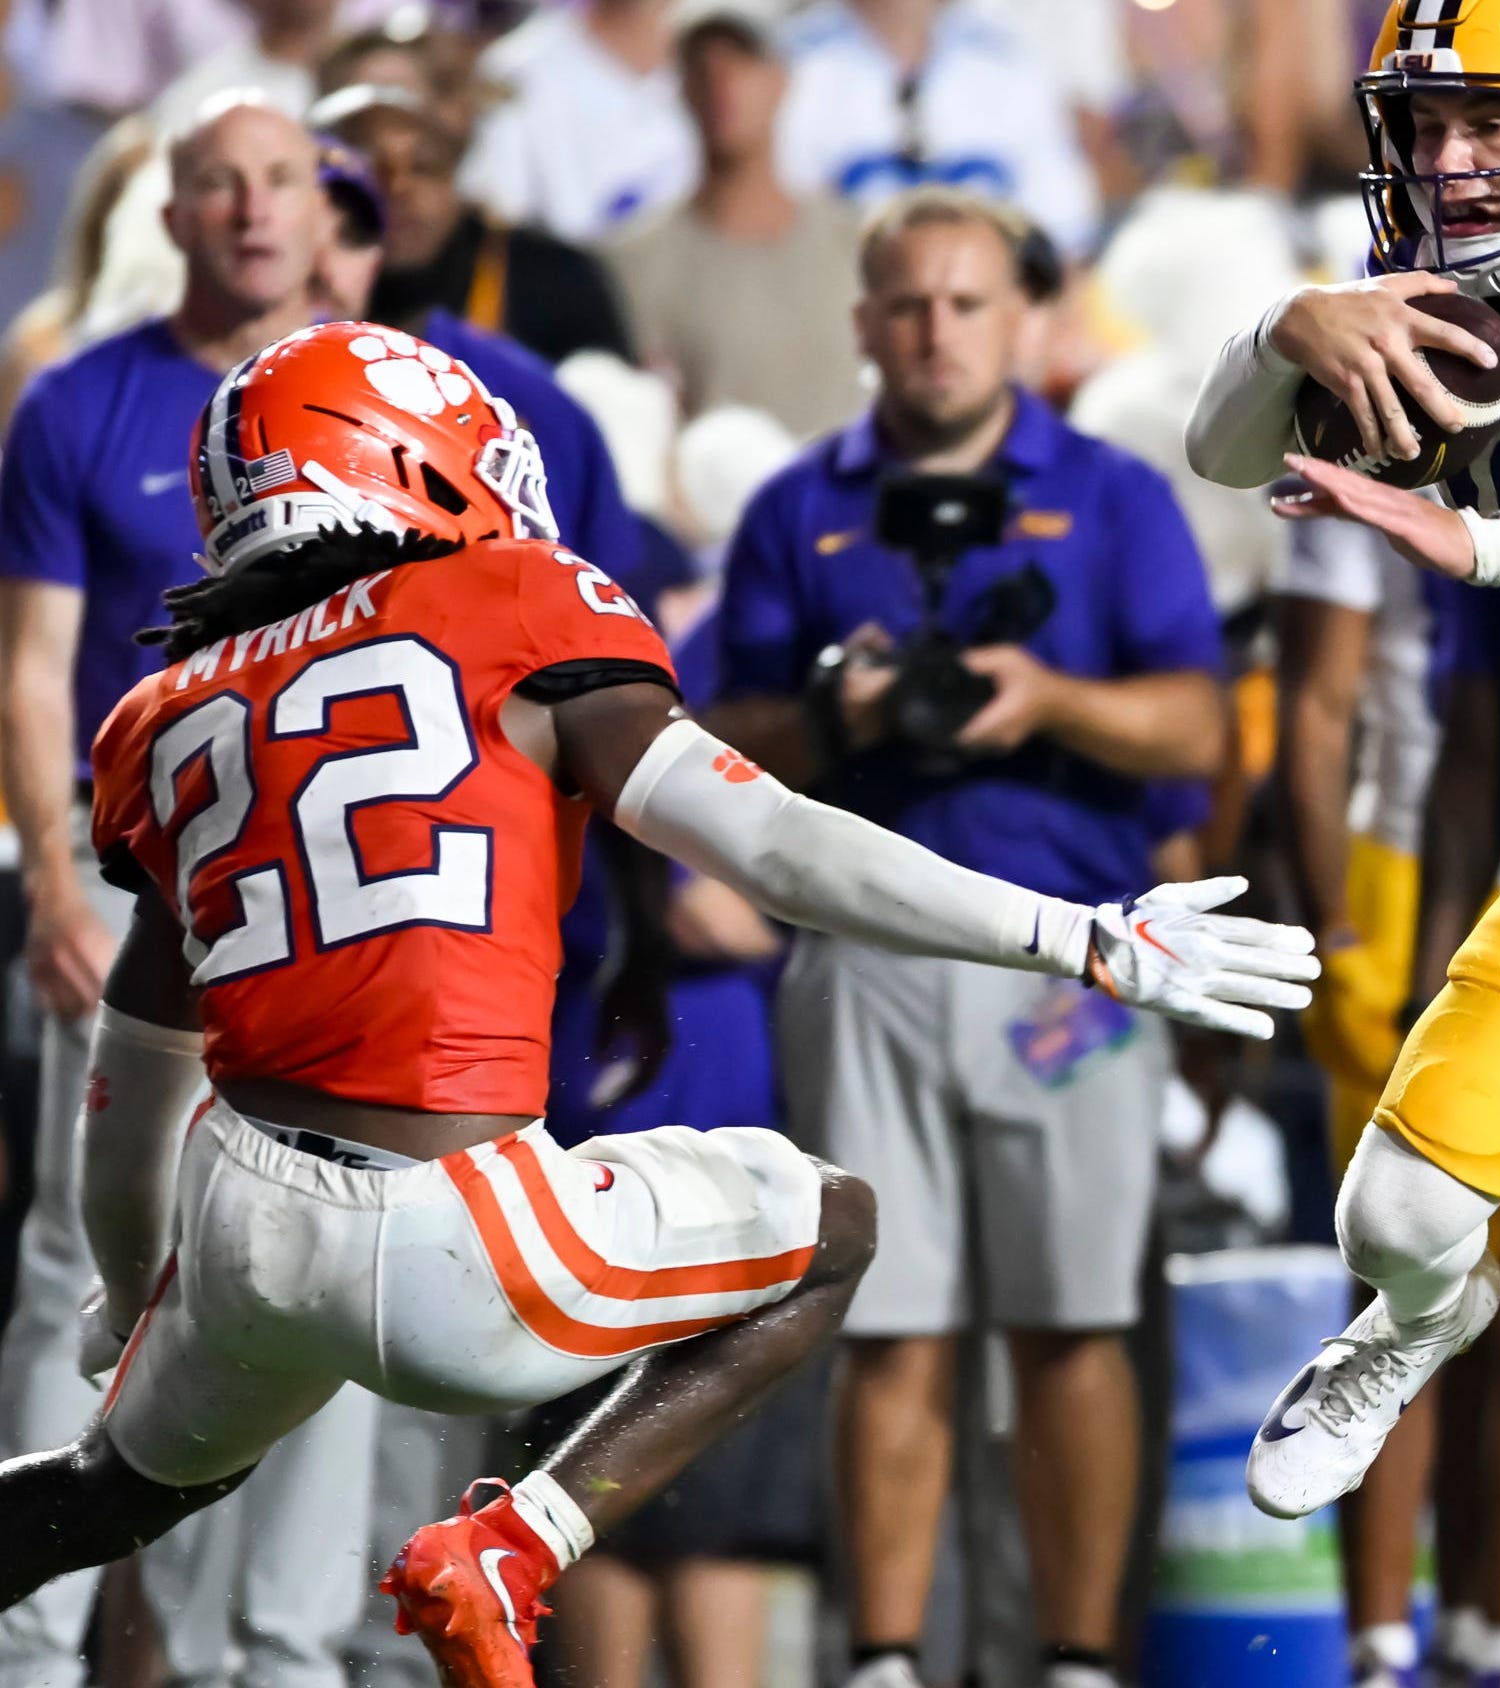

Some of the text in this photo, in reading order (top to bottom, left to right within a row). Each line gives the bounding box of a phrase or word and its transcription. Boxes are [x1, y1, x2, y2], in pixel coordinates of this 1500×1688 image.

[236, 477, 251, 499] 2
[175, 569, 393, 691] MYRICK
[552, 550, 655, 628] 2
[149, 631, 495, 988] 22
